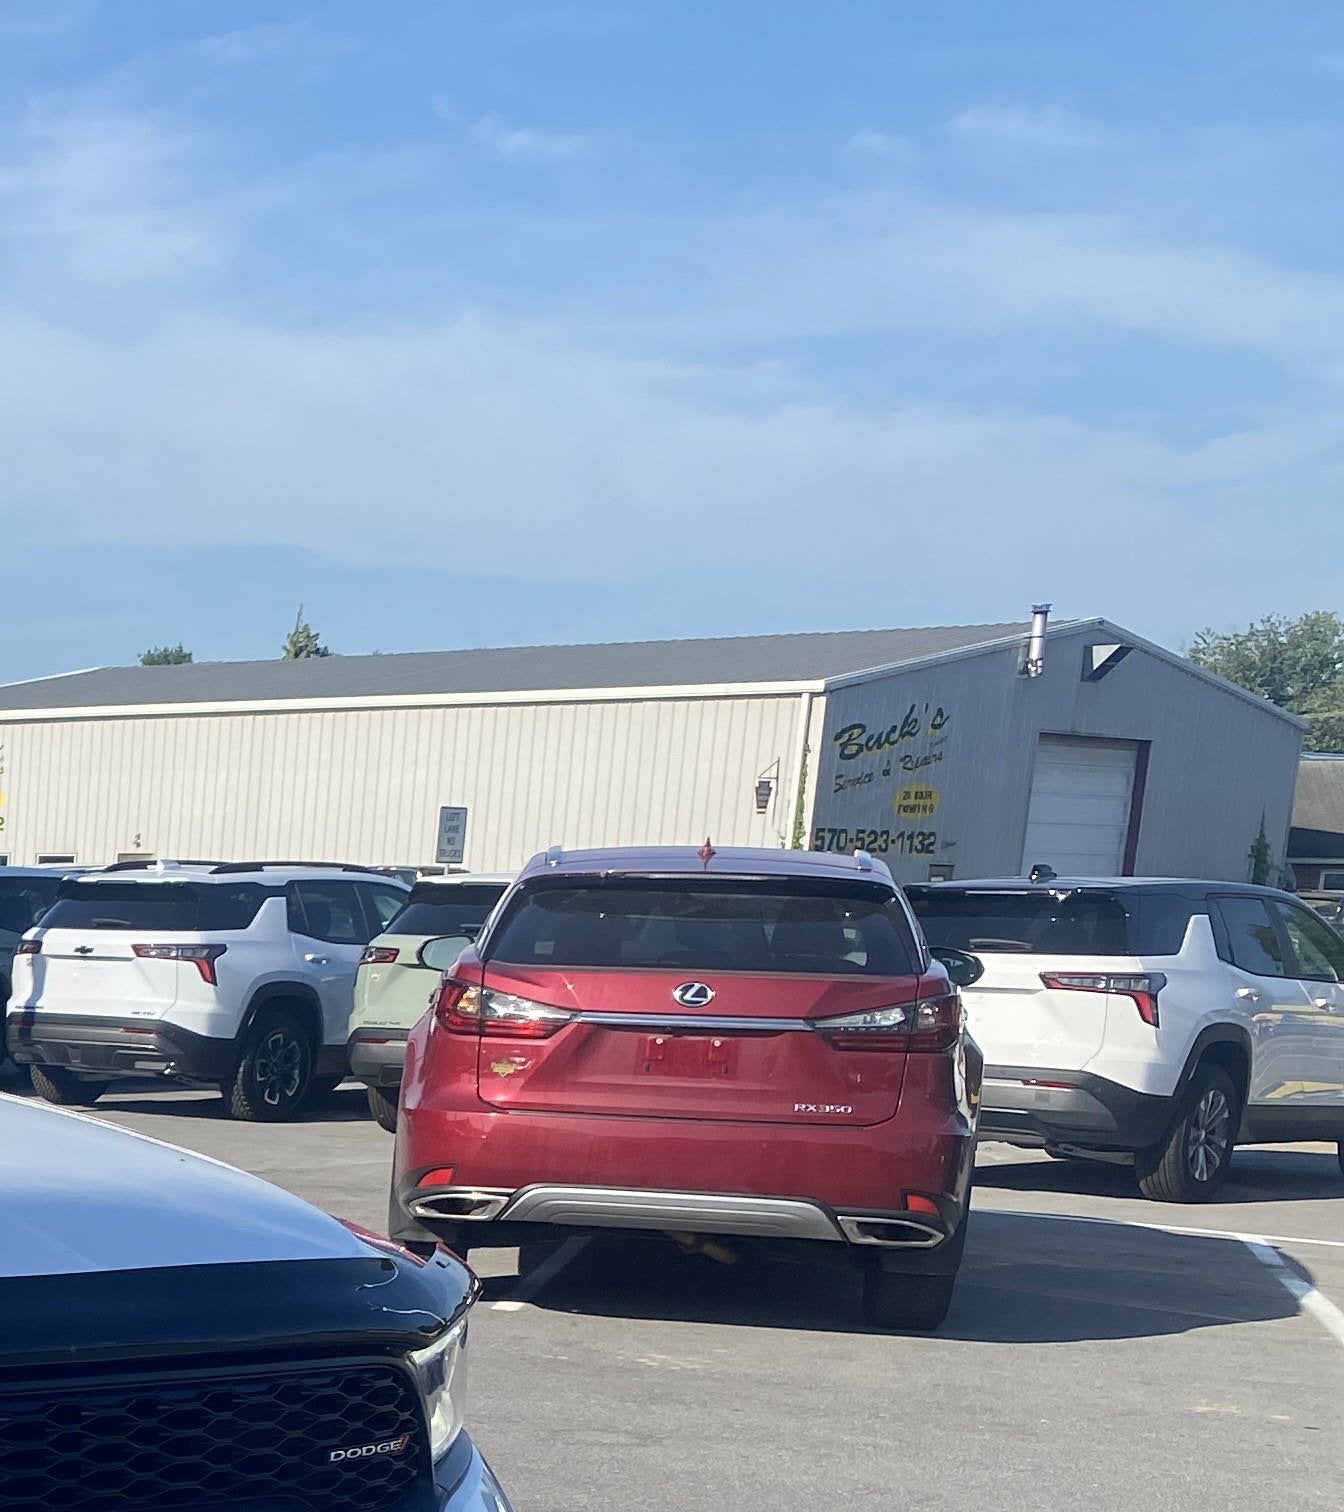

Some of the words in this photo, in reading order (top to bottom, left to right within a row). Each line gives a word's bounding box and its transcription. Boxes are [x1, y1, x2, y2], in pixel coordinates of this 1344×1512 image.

[833, 702, 951, 761] Buck's
[815, 827, 937, 855] 570-523-1132
[793, 1103, 817, 1112] RX
[329, 1439, 402, 1462] DODGE
